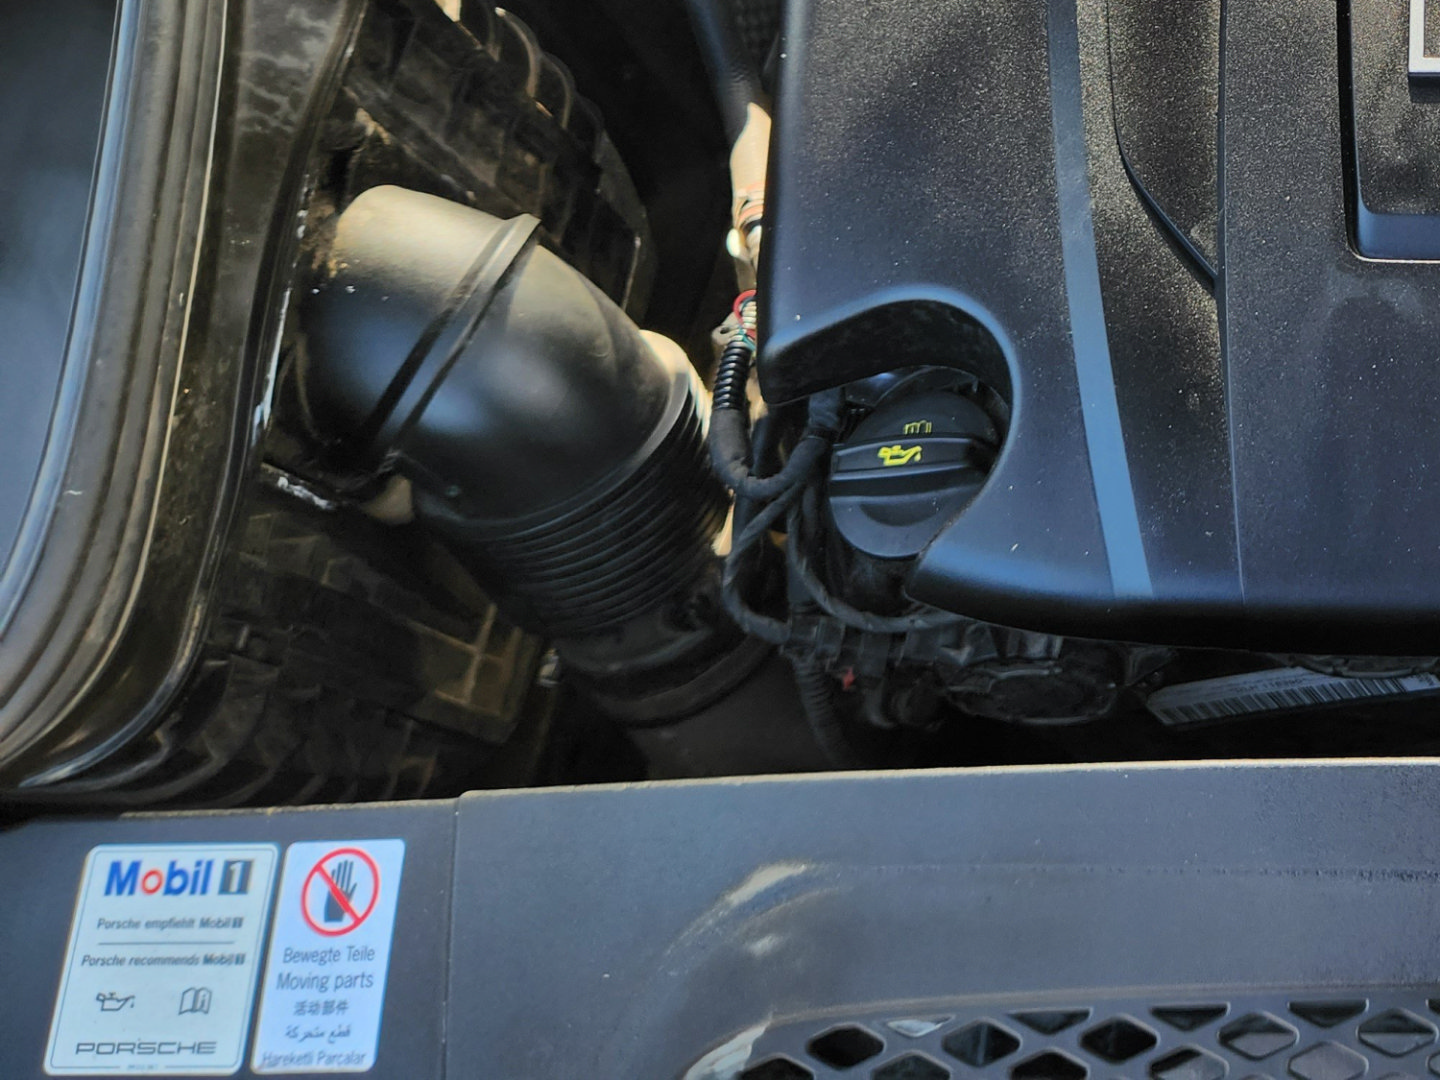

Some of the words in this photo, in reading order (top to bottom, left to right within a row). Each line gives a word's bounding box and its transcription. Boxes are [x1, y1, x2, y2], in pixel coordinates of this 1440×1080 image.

[104, 859, 215, 896] Mobil
[97, 917, 140, 930] Porsche
[144, 917, 195, 931] empfiehlt
[81, 954, 126, 966] Porsche
[128, 954, 200, 966] recommends
[282, 946, 341, 966] Bewegte
[346, 945, 376, 961] Teile
[276, 972, 330, 993] Moving
[333, 972, 374, 993] parts
[75, 1041, 217, 1055] PORSCHE
